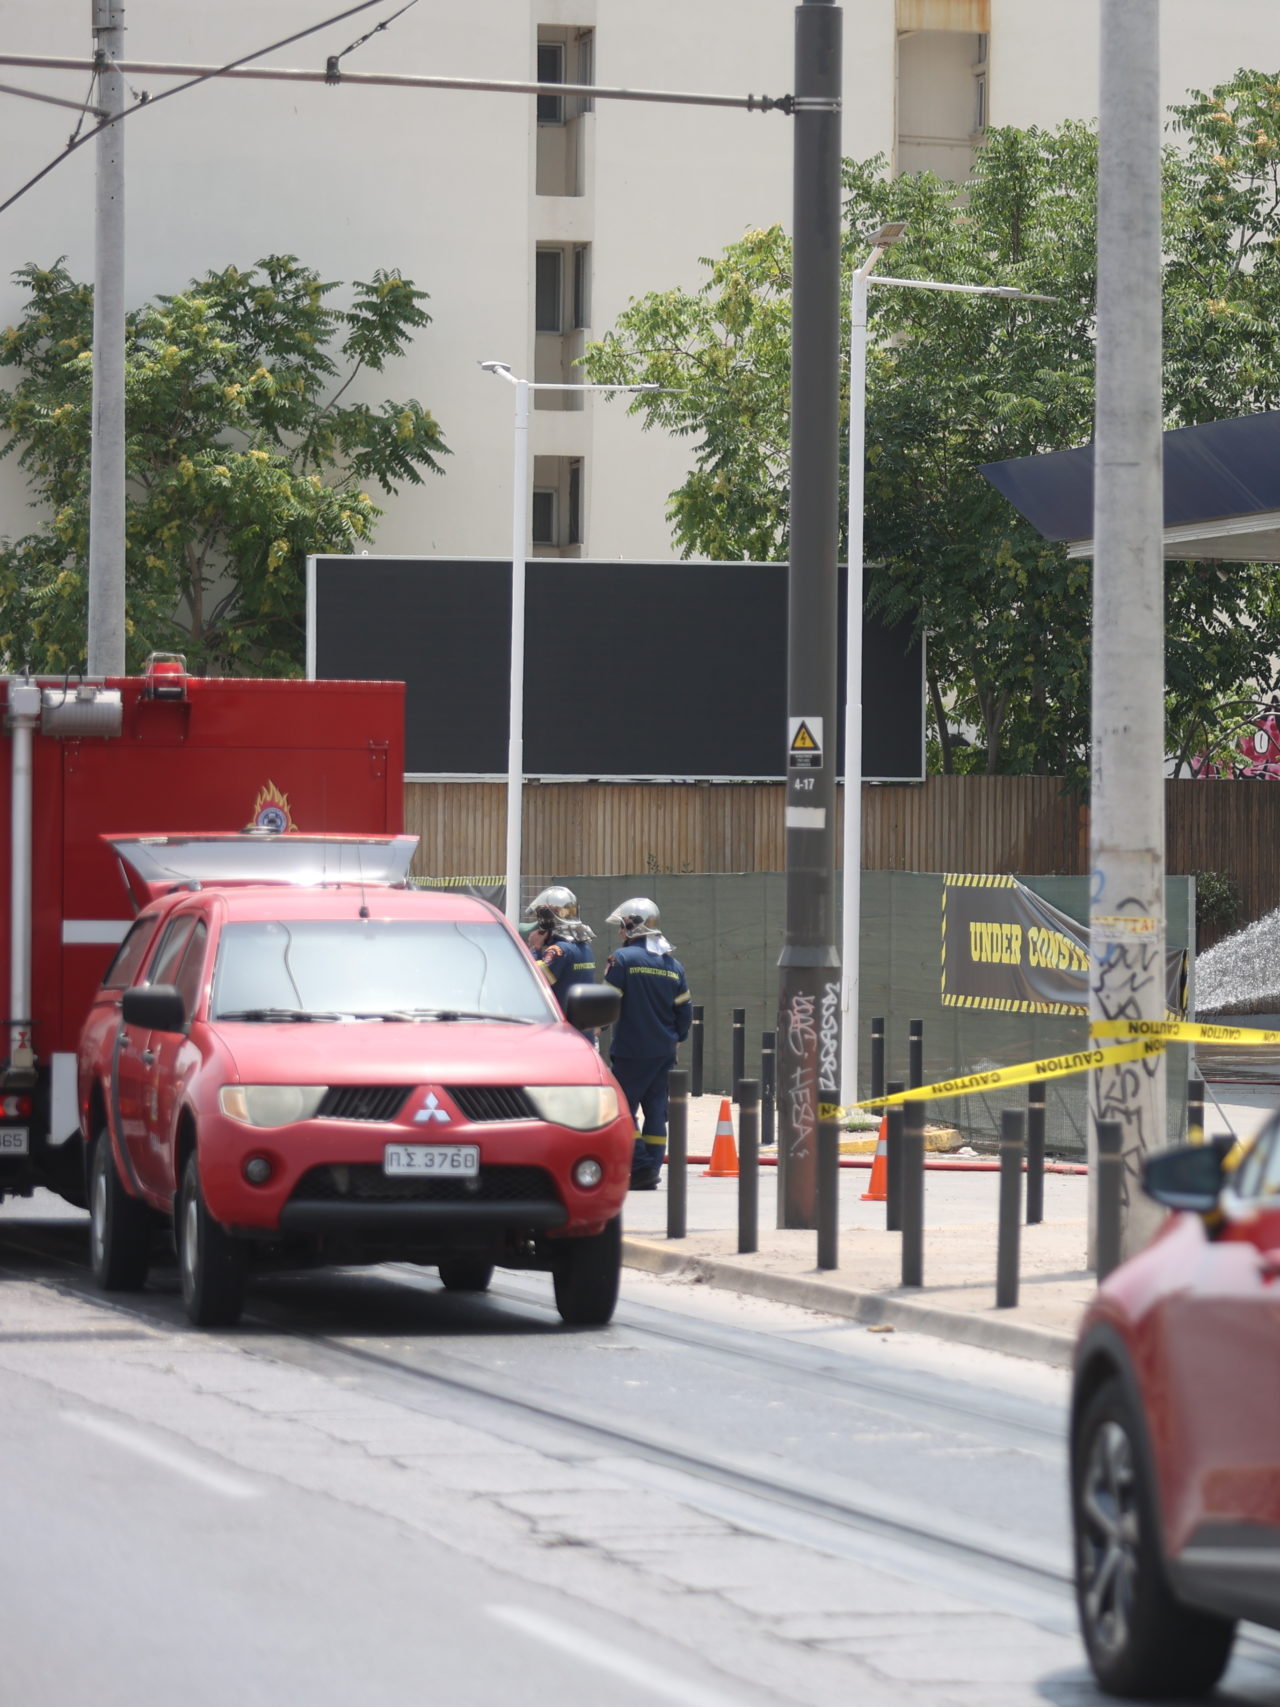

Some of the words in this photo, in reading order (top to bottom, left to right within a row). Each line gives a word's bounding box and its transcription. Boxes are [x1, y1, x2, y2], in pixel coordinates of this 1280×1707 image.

[794, 778, 815, 790] 4-17
[969, 922, 1022, 964] UNDER
[1128, 1021, 1180, 1036] CAUTION
[1200, 1026, 1241, 1040] CAUTION
[1036, 1051, 1104, 1075] CAUTION
[932, 1073, 1000, 1094] CAUTION
